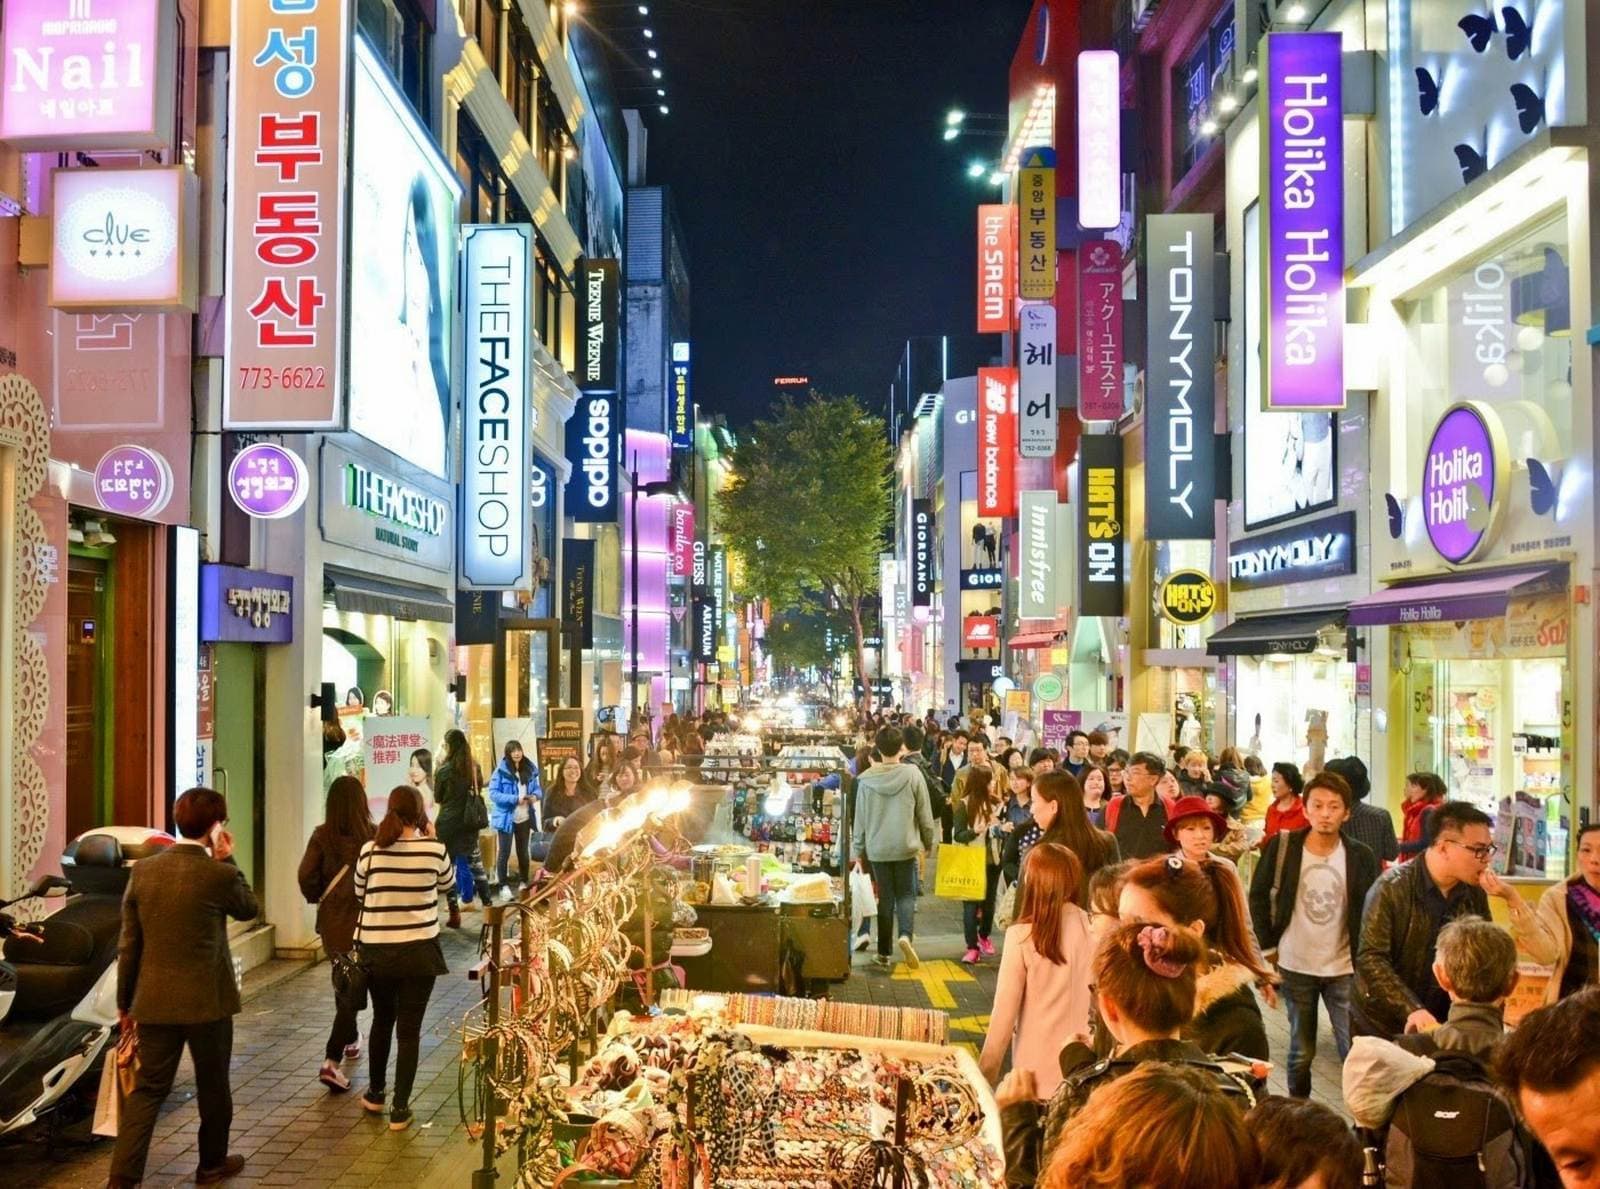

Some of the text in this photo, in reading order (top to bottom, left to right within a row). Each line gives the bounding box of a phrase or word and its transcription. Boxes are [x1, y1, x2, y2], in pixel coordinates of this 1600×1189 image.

[10, 41, 144, 92] Nail
[247, 0, 325, 347] 성 부동산
[984, 216, 1003, 246] the
[1283, 73, 1329, 366] Holika Holika
[587, 268, 604, 381] TEENIE WEENIE
[239, 367, 326, 390] 773-6622
[1169, 231, 1193, 519] TONYMOLY
[583, 398, 610, 507] adidas
[1430, 446, 1483, 489] Holika
[1429, 488, 1469, 526] Holi
[693, 541, 705, 586] GUESS
[916, 512, 928, 593] GIORDANO
[1087, 542, 1116, 582] ON
[1228, 533, 1344, 578] TONYMOLY
[702, 604, 712, 656] ARITAUM
